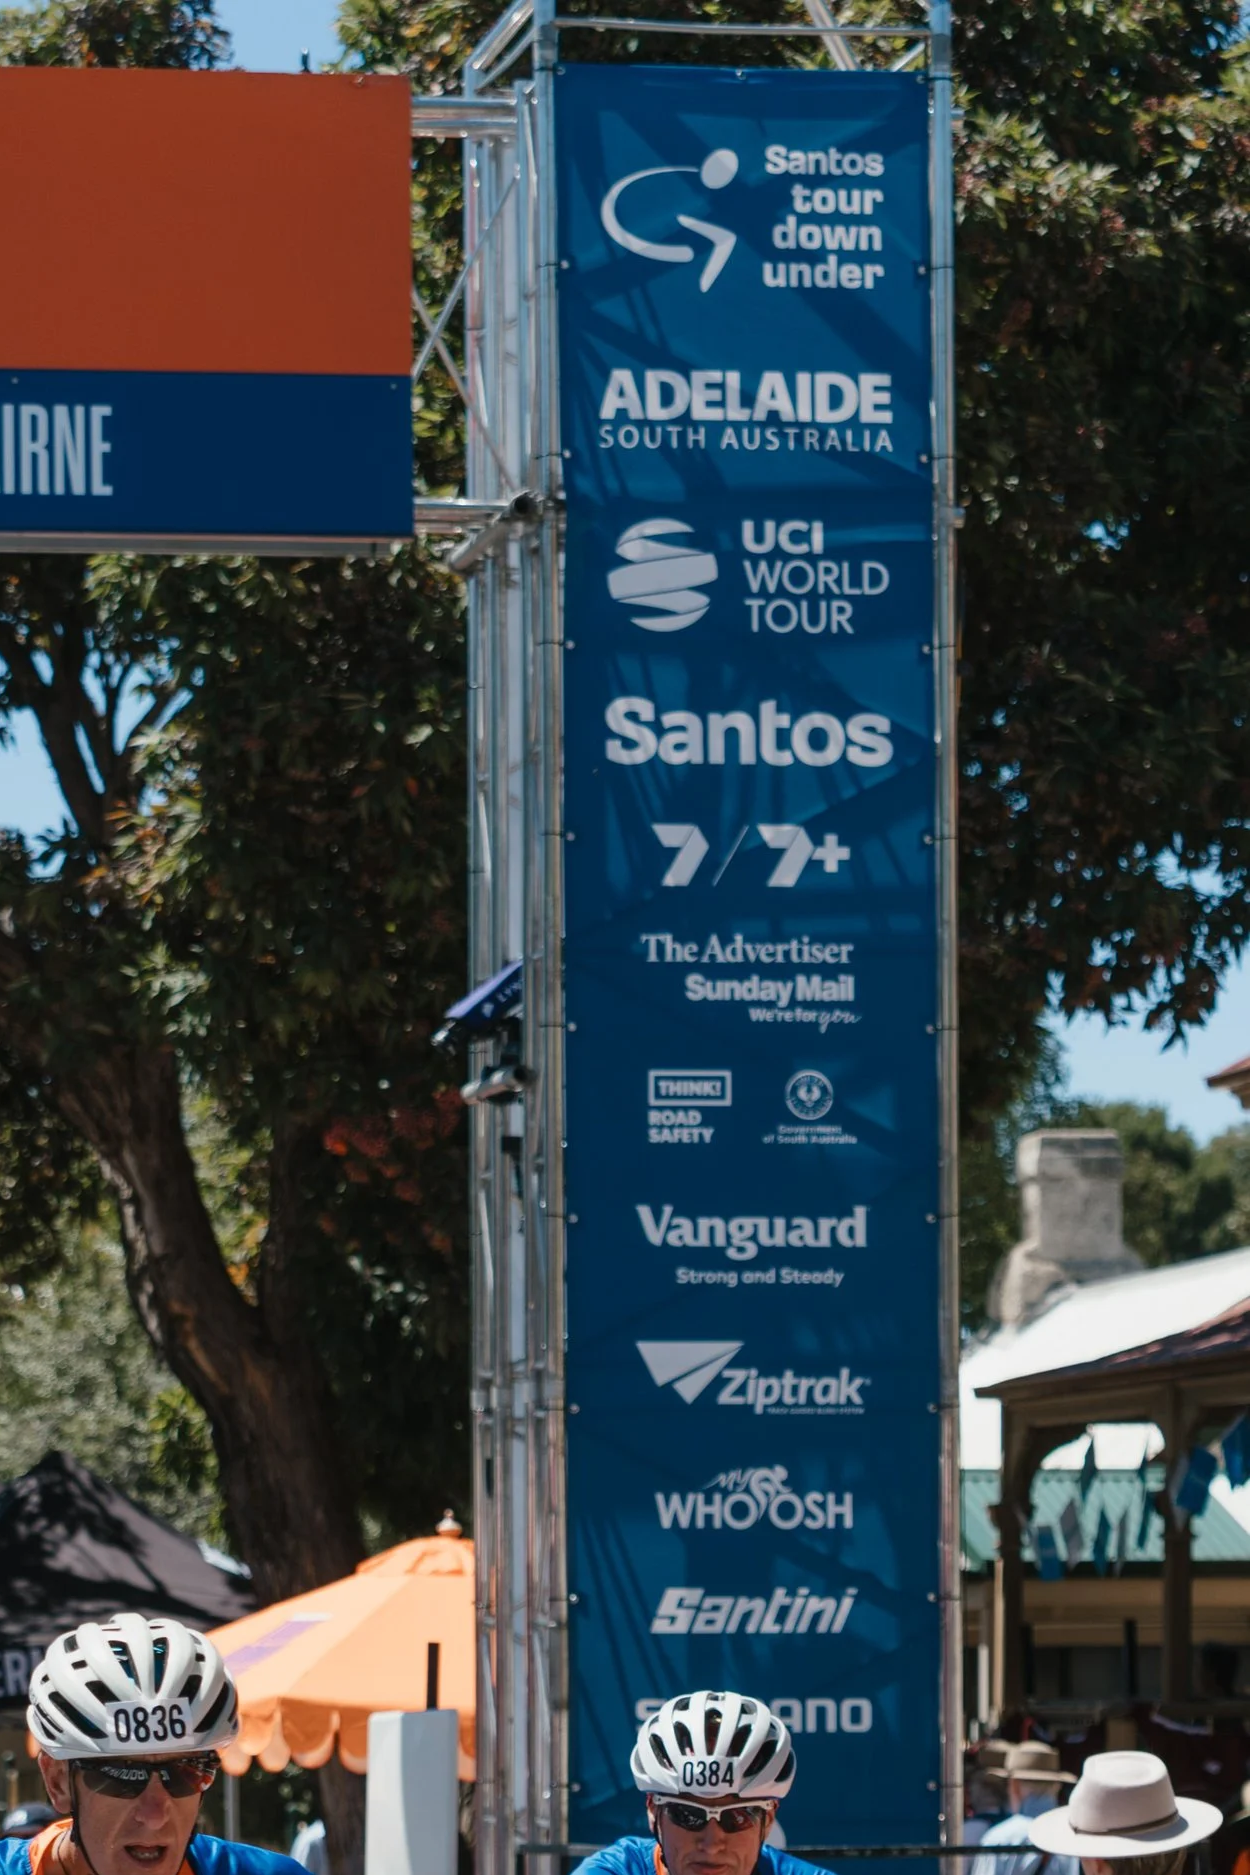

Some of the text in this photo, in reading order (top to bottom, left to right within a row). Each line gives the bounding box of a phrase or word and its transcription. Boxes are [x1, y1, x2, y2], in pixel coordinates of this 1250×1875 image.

[765, 144, 885, 177] Santos
[793, 184, 884, 216] tour
[772, 216, 883, 252] down
[763, 255, 885, 290] under
[599, 368, 893, 425] ADELAIDE
[599, 425, 894, 453] SOUTH AUSTRALIA
[741, 519, 824, 555] UCI
[743, 560, 890, 596] WORLD
[744, 598, 855, 634] TOUR
[604, 696, 894, 768] Santos
[641, 933, 855, 964] The Advertiser
[685, 973, 855, 1008] Sunday Mail
[749, 1007, 793, 1023] We're
[817, 1010, 862, 1034] you
[657, 1079, 722, 1097] THINK!
[648, 1110, 703, 1126] ROAD
[648, 1127, 715, 1144] SAFETY
[636, 1204, 868, 1261] Vanguard
[676, 1267, 845, 1288] Strong and Steady
[717, 1367, 864, 1414] Ziptrak
[655, 1493, 853, 1530] WHOOSH
[650, 1587, 858, 1634] Santini
[114, 1704, 187, 1743] 0836
[682, 1760, 735, 1788] 0384
